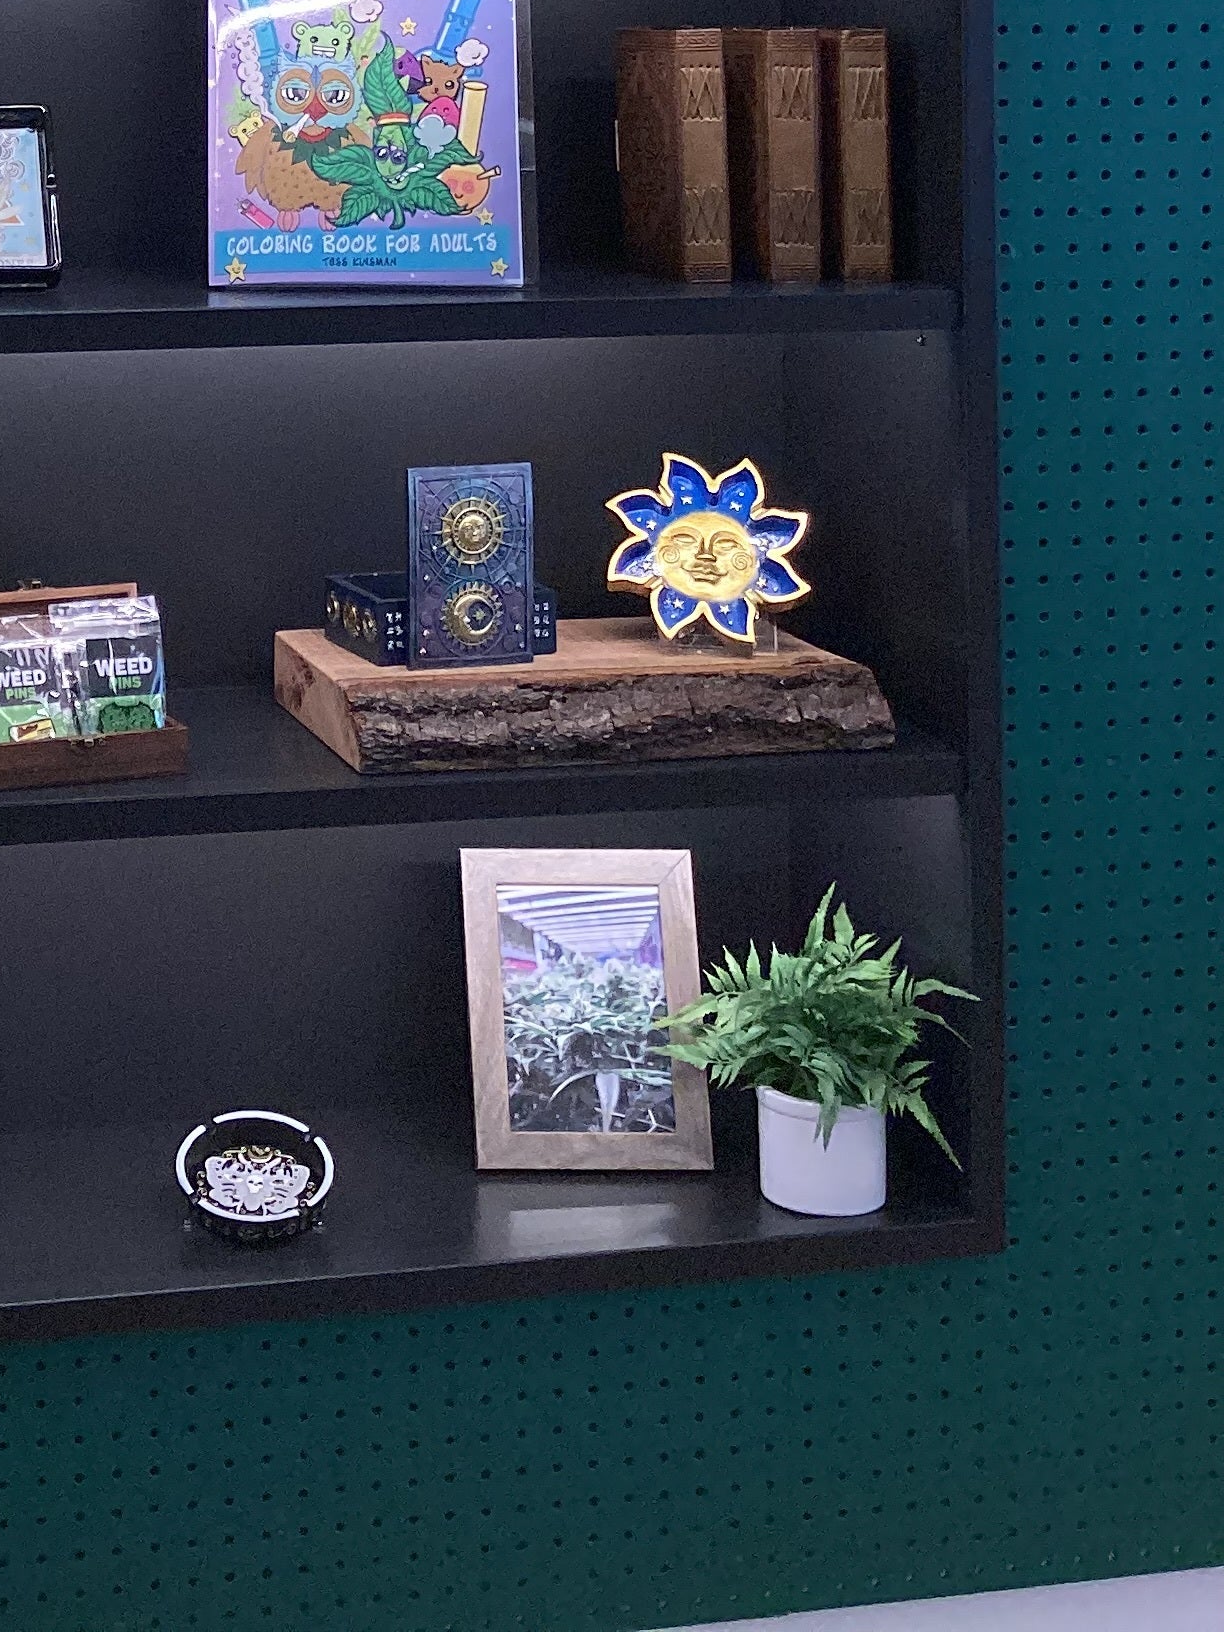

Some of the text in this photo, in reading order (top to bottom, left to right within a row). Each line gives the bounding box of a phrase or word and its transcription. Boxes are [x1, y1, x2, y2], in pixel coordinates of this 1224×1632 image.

[226, 232, 498, 256] COLORING BOOK FOR ADULTS
[95, 656, 153, 677] WEED
[5, 687, 36, 700] PINS
